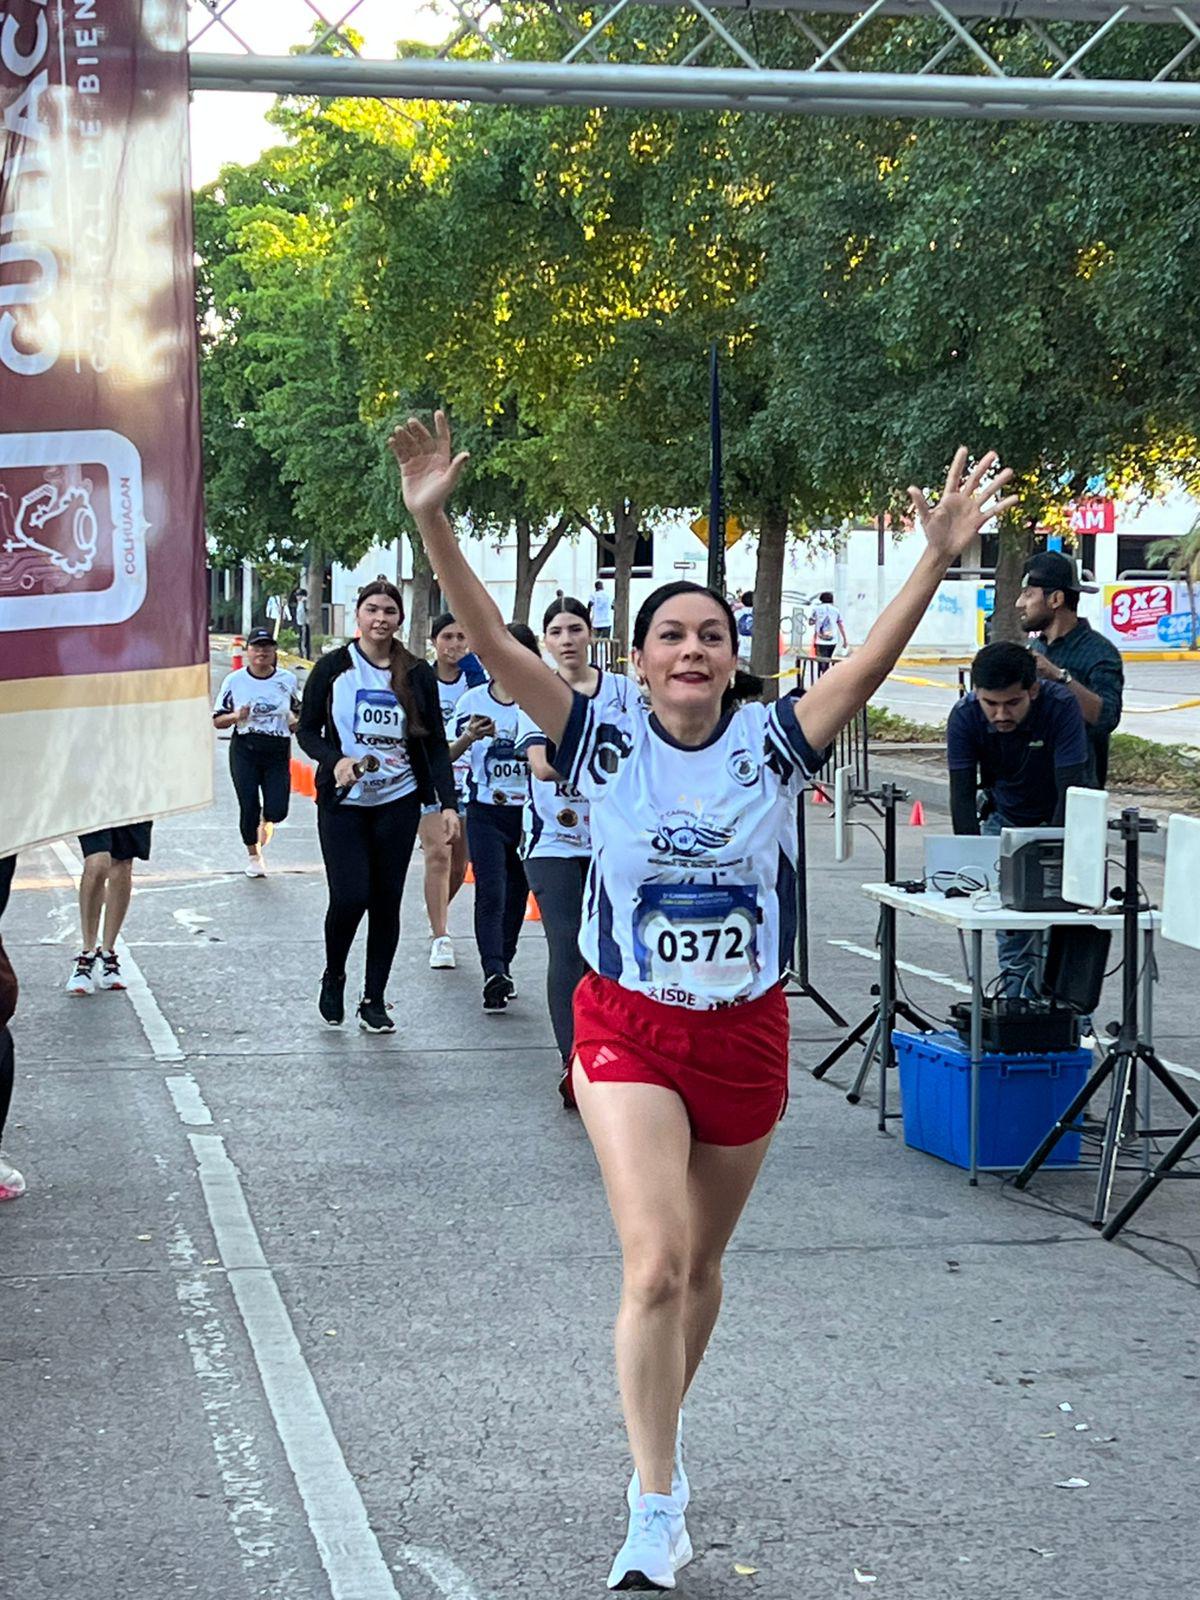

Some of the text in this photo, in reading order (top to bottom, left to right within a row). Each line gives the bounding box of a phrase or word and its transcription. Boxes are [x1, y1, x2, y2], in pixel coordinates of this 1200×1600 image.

[79, 118, 102, 169] DE
[0, 0, 61, 376] CULIAC
[120, 477, 136, 575] COLHUACAN
[363, 708, 398, 726] 0051
[494, 763, 528, 778] 0041
[657, 926, 745, 964] 0372
[660, 987, 696, 1006] ISDE
